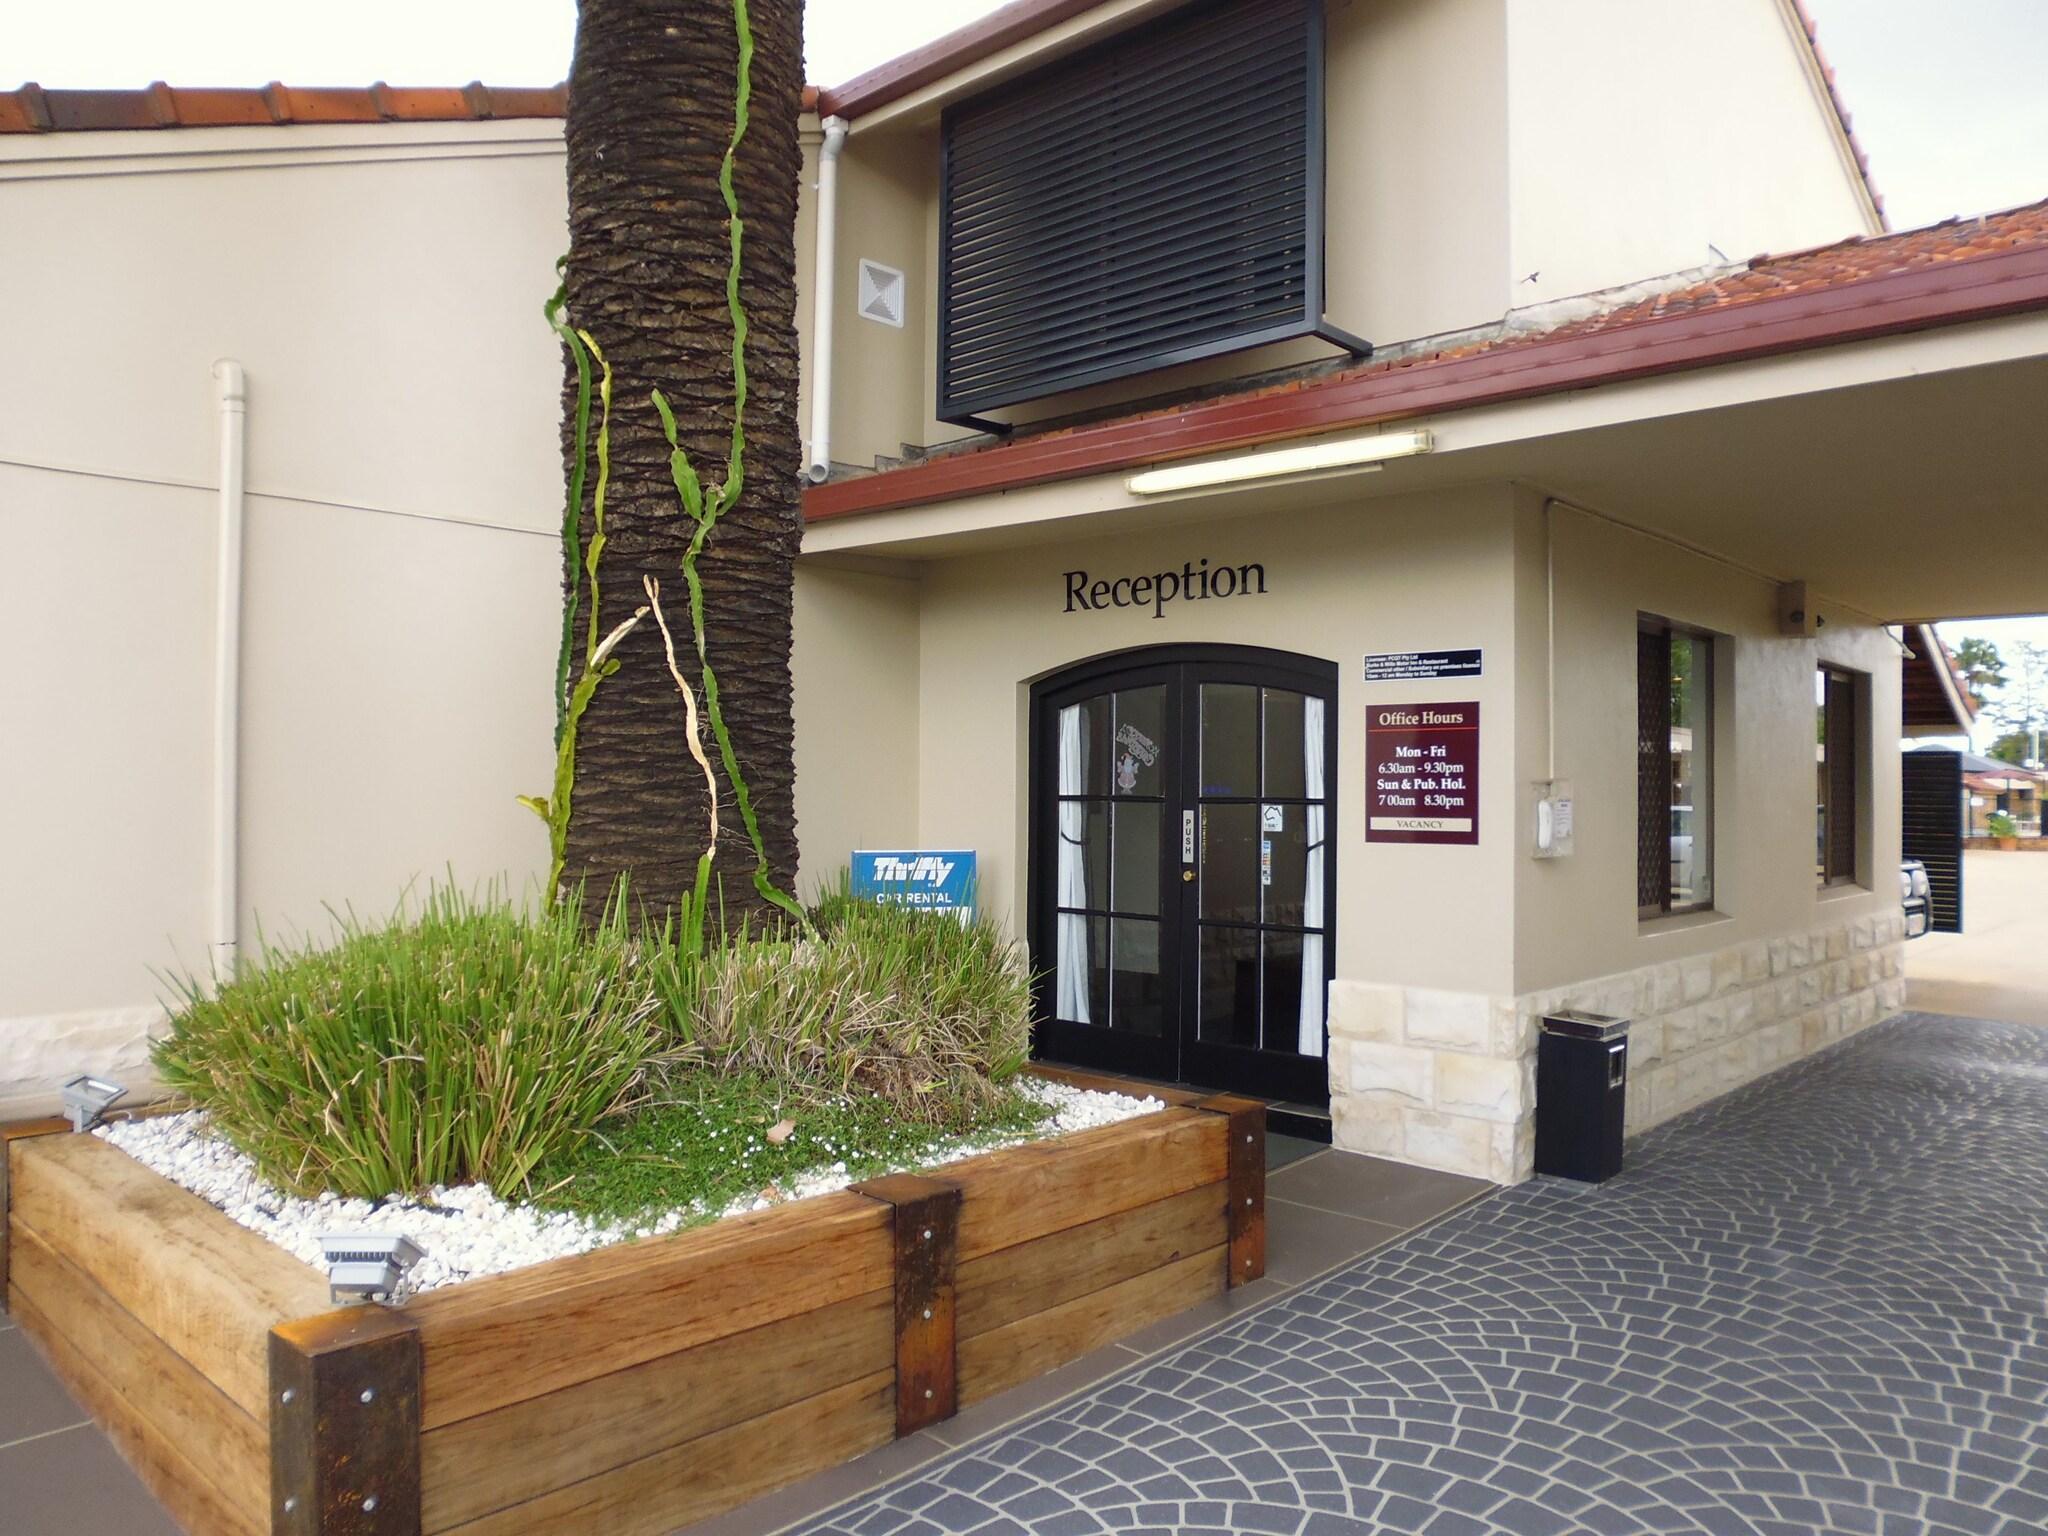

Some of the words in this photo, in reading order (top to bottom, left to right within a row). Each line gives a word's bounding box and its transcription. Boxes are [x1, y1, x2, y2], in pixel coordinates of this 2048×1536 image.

[1062, 558, 1269, 619] Reception
[1379, 712, 1420, 726] Office
[1422, 711, 1464, 725] Hours
[1395, 746, 1421, 757] Mon
[1430, 745, 1447, 757] Fri
[1378, 762, 1416, 774] 6.30am
[1424, 762, 1464, 776] 9.30pm
[1377, 779, 1399, 790] Sun
[1401, 779, 1412, 790] &
[1414, 778, 1439, 790] Pub.
[1440, 777, 1466, 790] Hol.
[1424, 794, 1465, 810] 8.30pm
[1396, 819, 1445, 829] VACANCY
[906, 892, 953, 904] RENTAL
